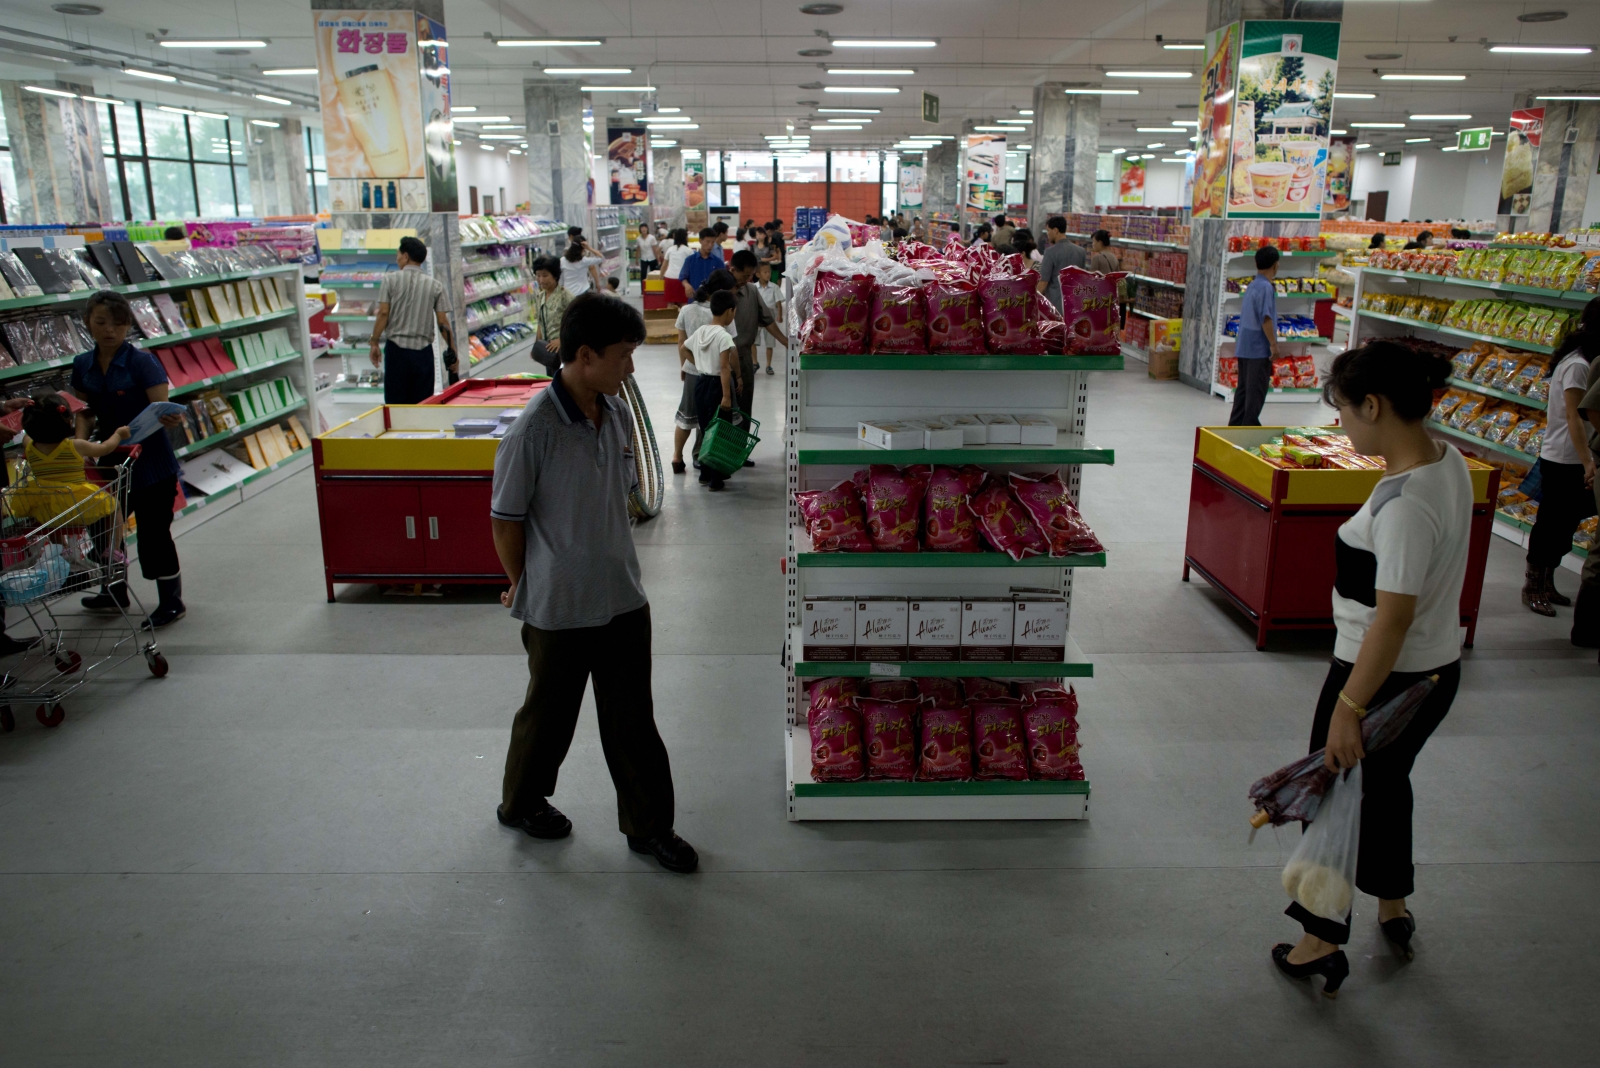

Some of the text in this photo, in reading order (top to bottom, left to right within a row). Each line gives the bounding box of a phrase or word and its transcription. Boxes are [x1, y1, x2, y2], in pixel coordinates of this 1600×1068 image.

[337, 29, 408, 54] 화장품
[1203, 63, 1220, 160] 과자
[1463, 132, 1487, 147] 사탕
[997, 291, 1032, 323] 과자
[1081, 292, 1117, 326] 과자
[821, 721, 855, 749] 과자
[874, 717, 907, 747] 과자
[930, 721, 965, 748] 과자
[1037, 717, 1071, 749] 과자
